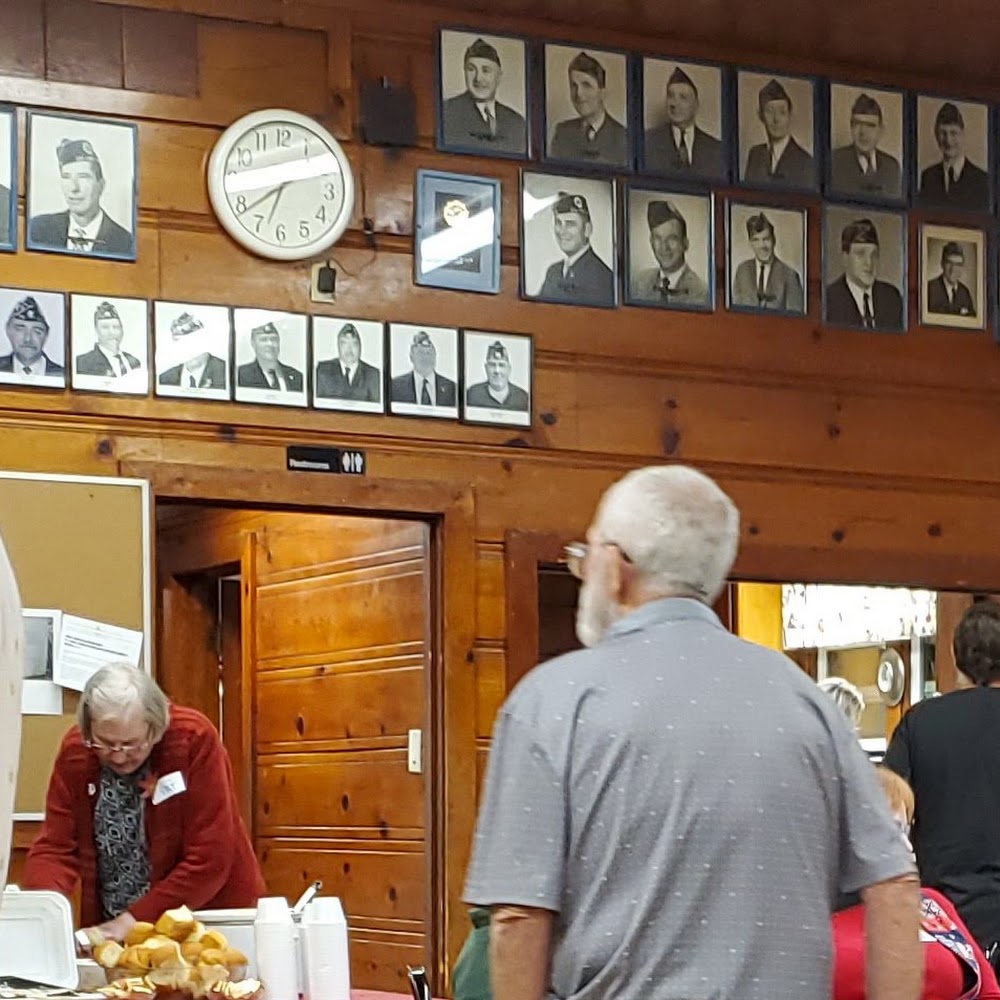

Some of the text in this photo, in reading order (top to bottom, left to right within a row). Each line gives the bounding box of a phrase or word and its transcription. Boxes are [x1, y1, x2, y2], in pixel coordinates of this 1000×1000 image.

[255, 132, 267, 151] 11
[276, 129, 291, 148] 12
[237, 147, 252, 167] 10
[323, 183, 335, 201] 3
[236, 195, 247, 213] 8
[254, 214, 265, 233] 7
[315, 205, 326, 224] 4
[275, 224, 286, 242] 6
[299, 221, 310, 238] 5
